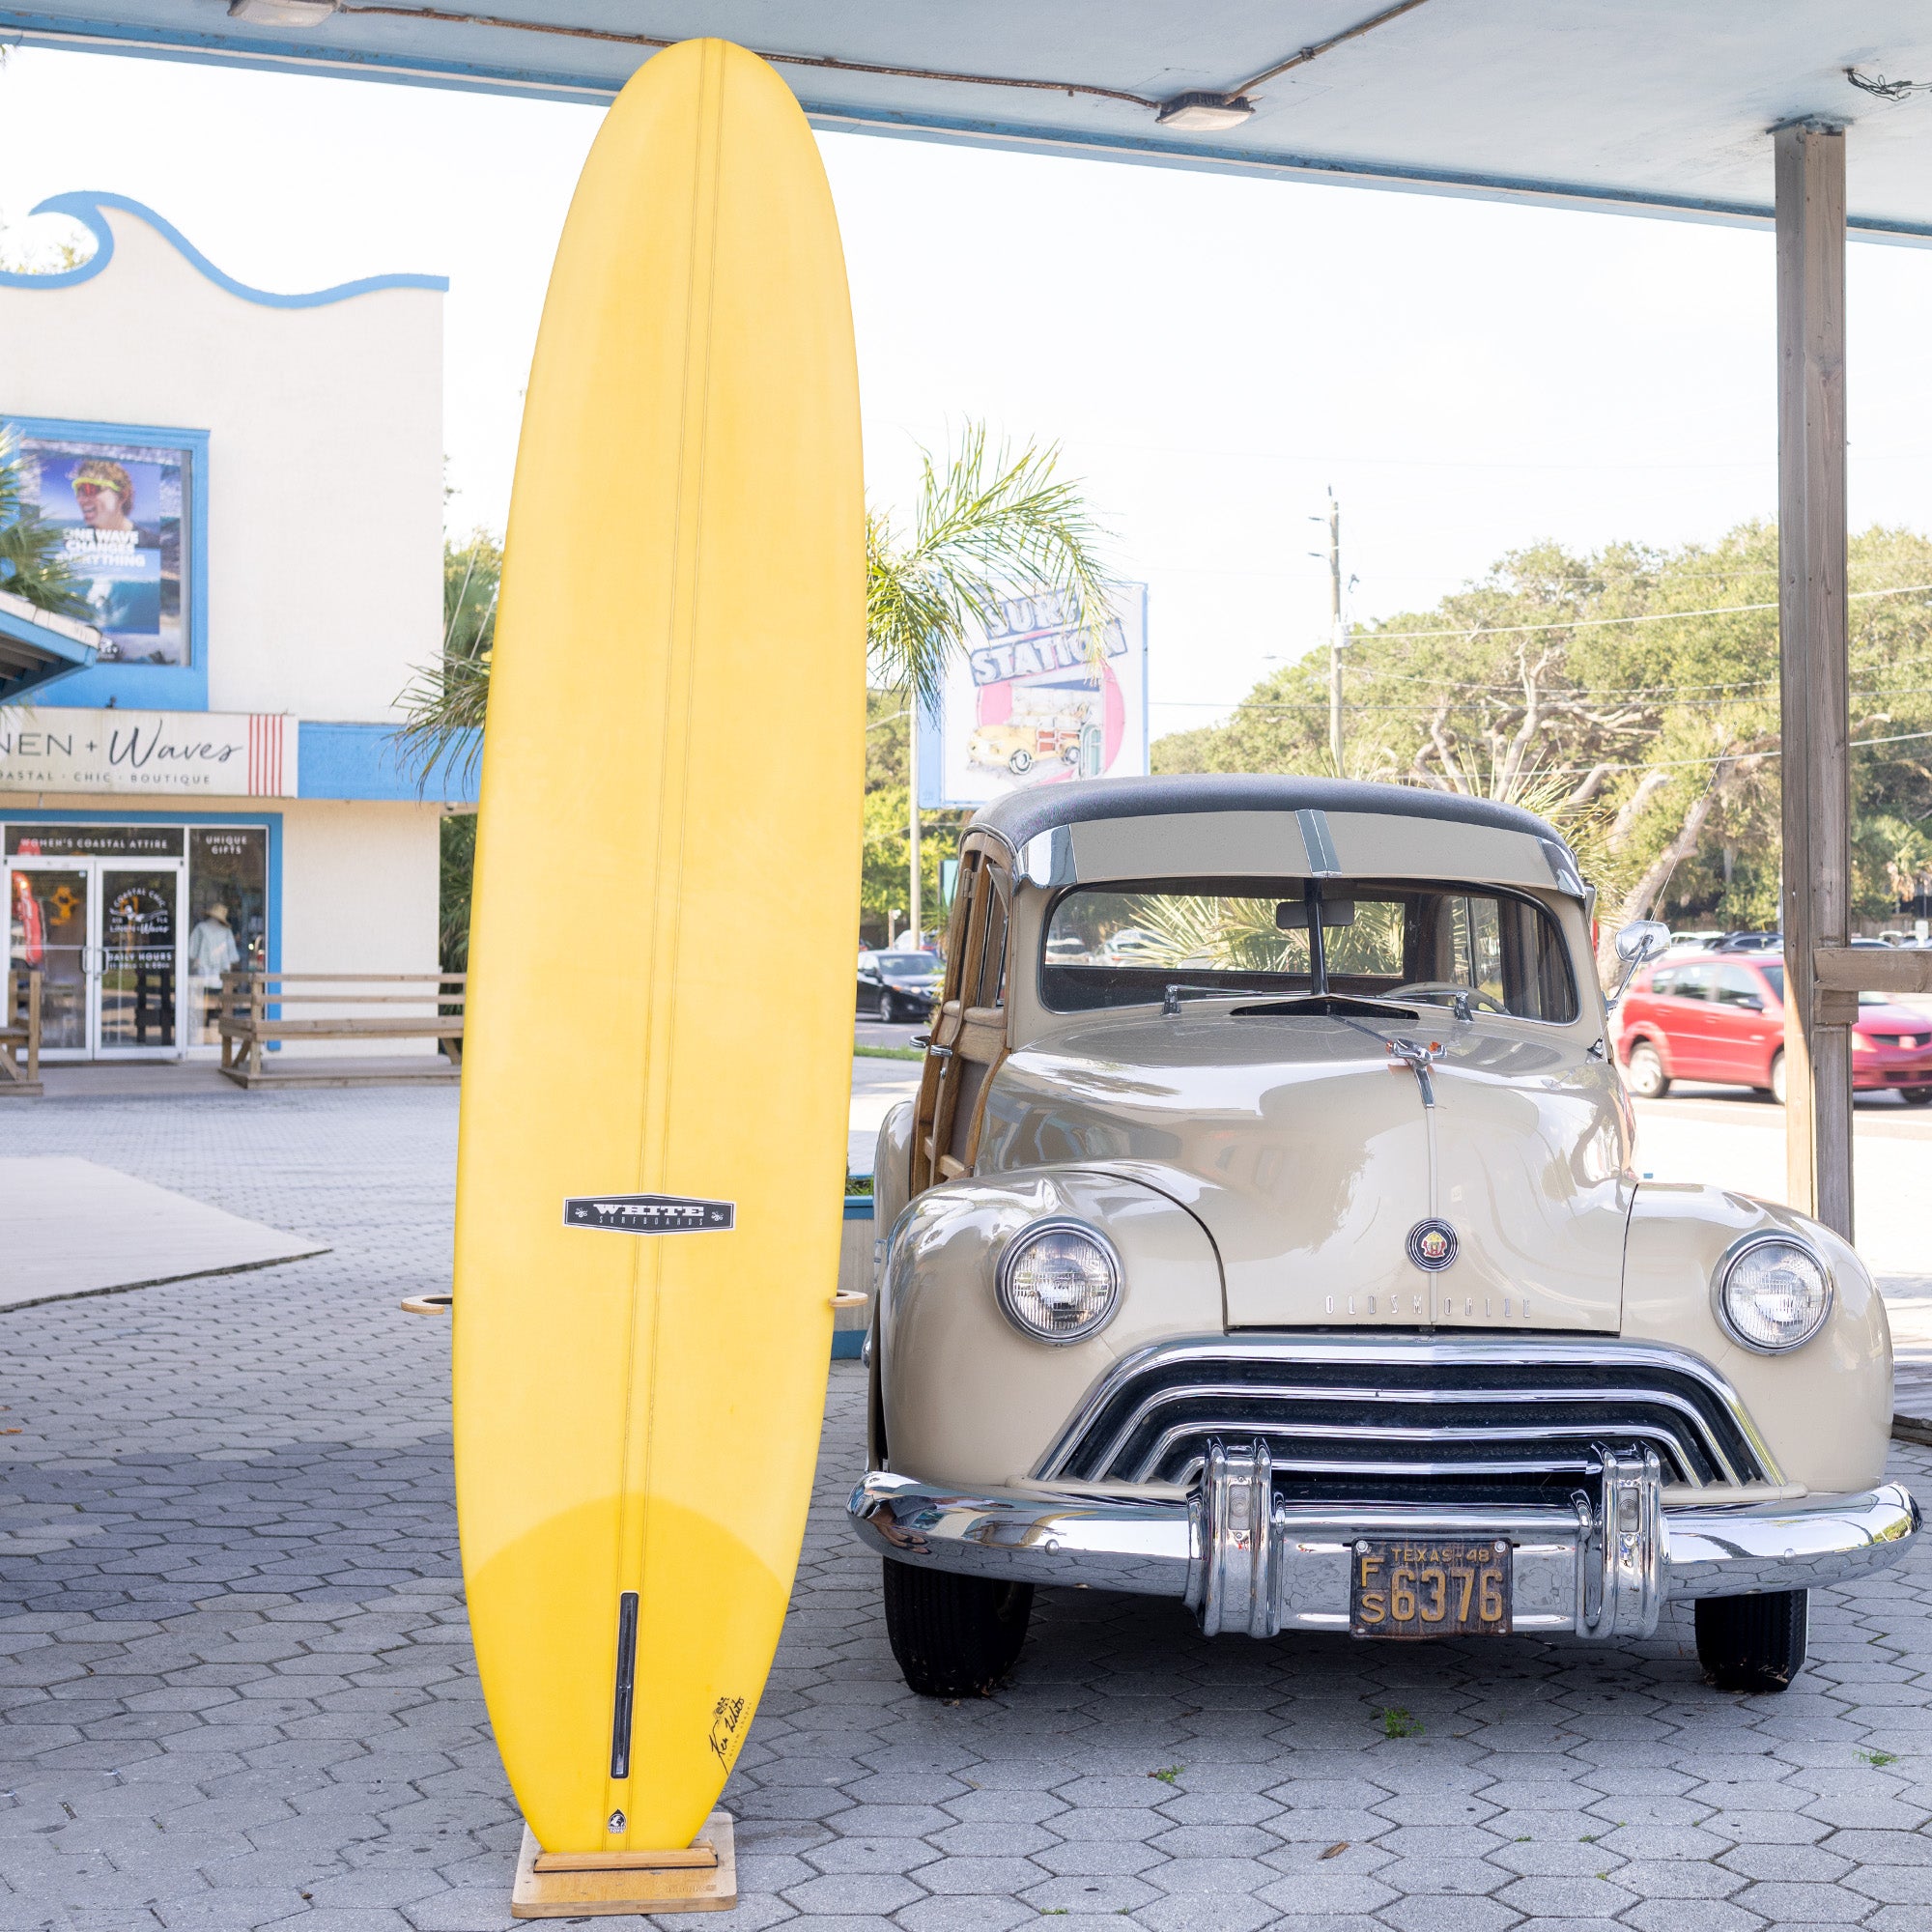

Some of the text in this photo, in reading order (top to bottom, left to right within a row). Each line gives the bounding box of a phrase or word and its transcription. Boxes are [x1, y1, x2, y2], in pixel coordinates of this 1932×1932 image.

[63, 528, 138, 544] ONE WAVE
[65, 540, 135, 554] CHANGES
[984, 589, 1080, 639] SURF
[971, 619, 1126, 680] STATION
[109, 718, 243, 768] Waves
[73, 773, 111, 782] CHIC
[130, 774, 210, 784] BOUTIQUE
[20, 838, 168, 849] WOMEN'S COASTAL ATTIRE
[206, 836, 247, 845] UNIQUE
[212, 845, 242, 855] GIFTS
[138, 952, 172, 961] HOURS
[593, 1204, 704, 1216] WHITE
[599, 1216, 703, 1226] SURFBOARDS
[1325, 1295, 1530, 1318] OLDSMOBILE
[1361, 1557, 1385, 1588] F
[1391, 1569, 1503, 1622] 6376
[1360, 1594, 1385, 1623] S
